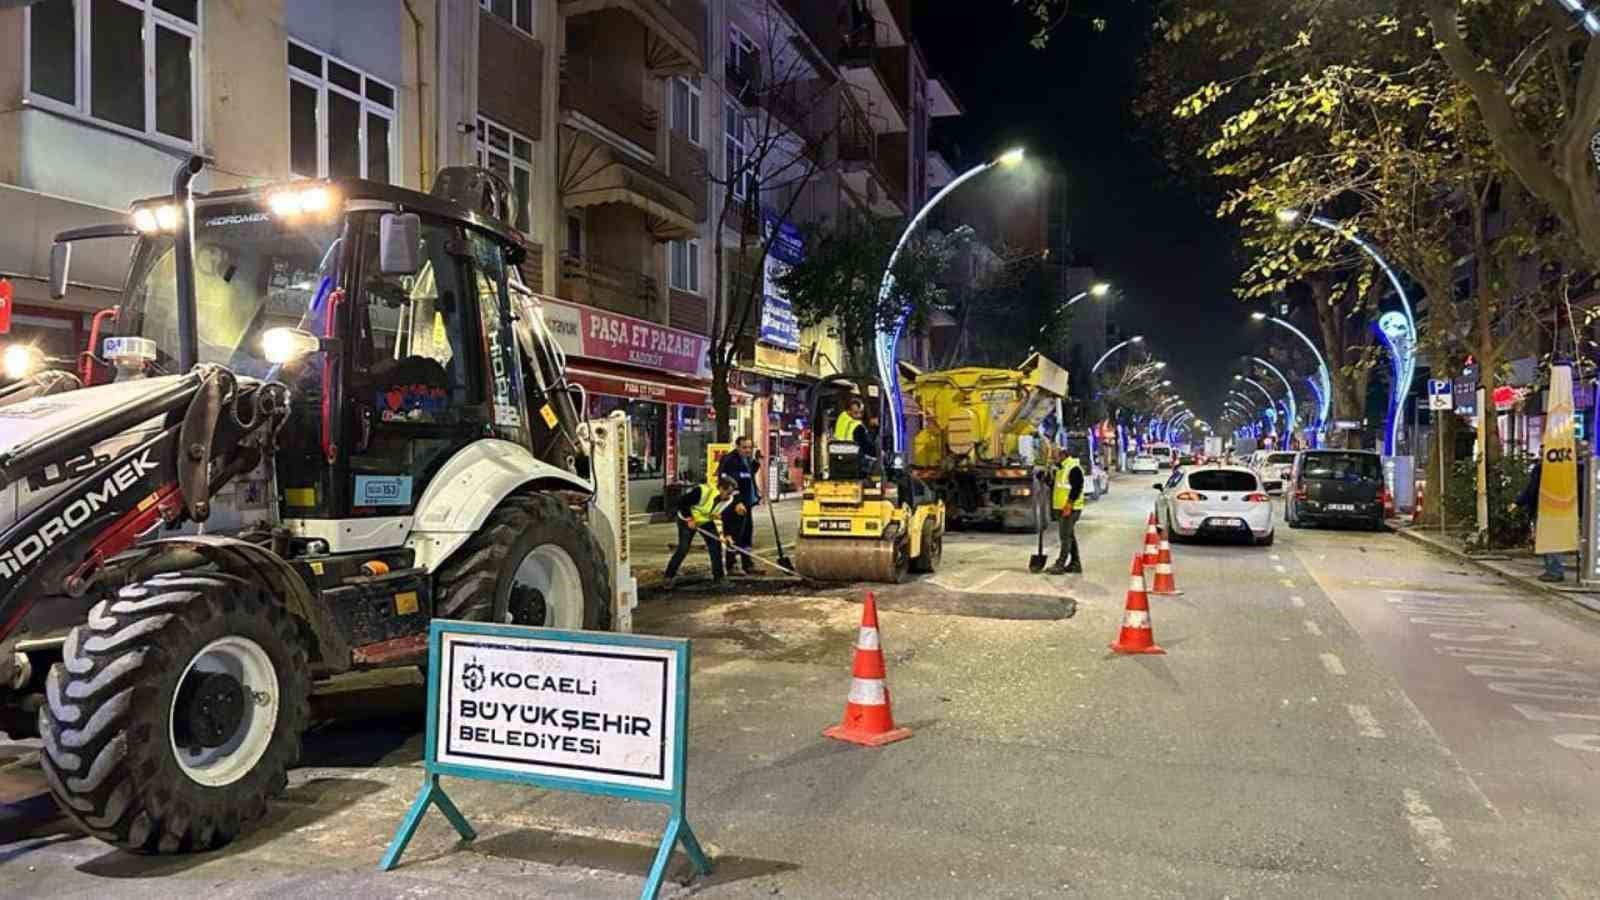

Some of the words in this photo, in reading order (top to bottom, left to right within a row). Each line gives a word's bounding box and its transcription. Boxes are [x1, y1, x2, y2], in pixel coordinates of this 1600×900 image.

[589, 314, 629, 349] PAŞA
[632, 326, 650, 349] ET
[651, 330, 696, 358] PAZARI
[1434, 382, 1446, 394] P
